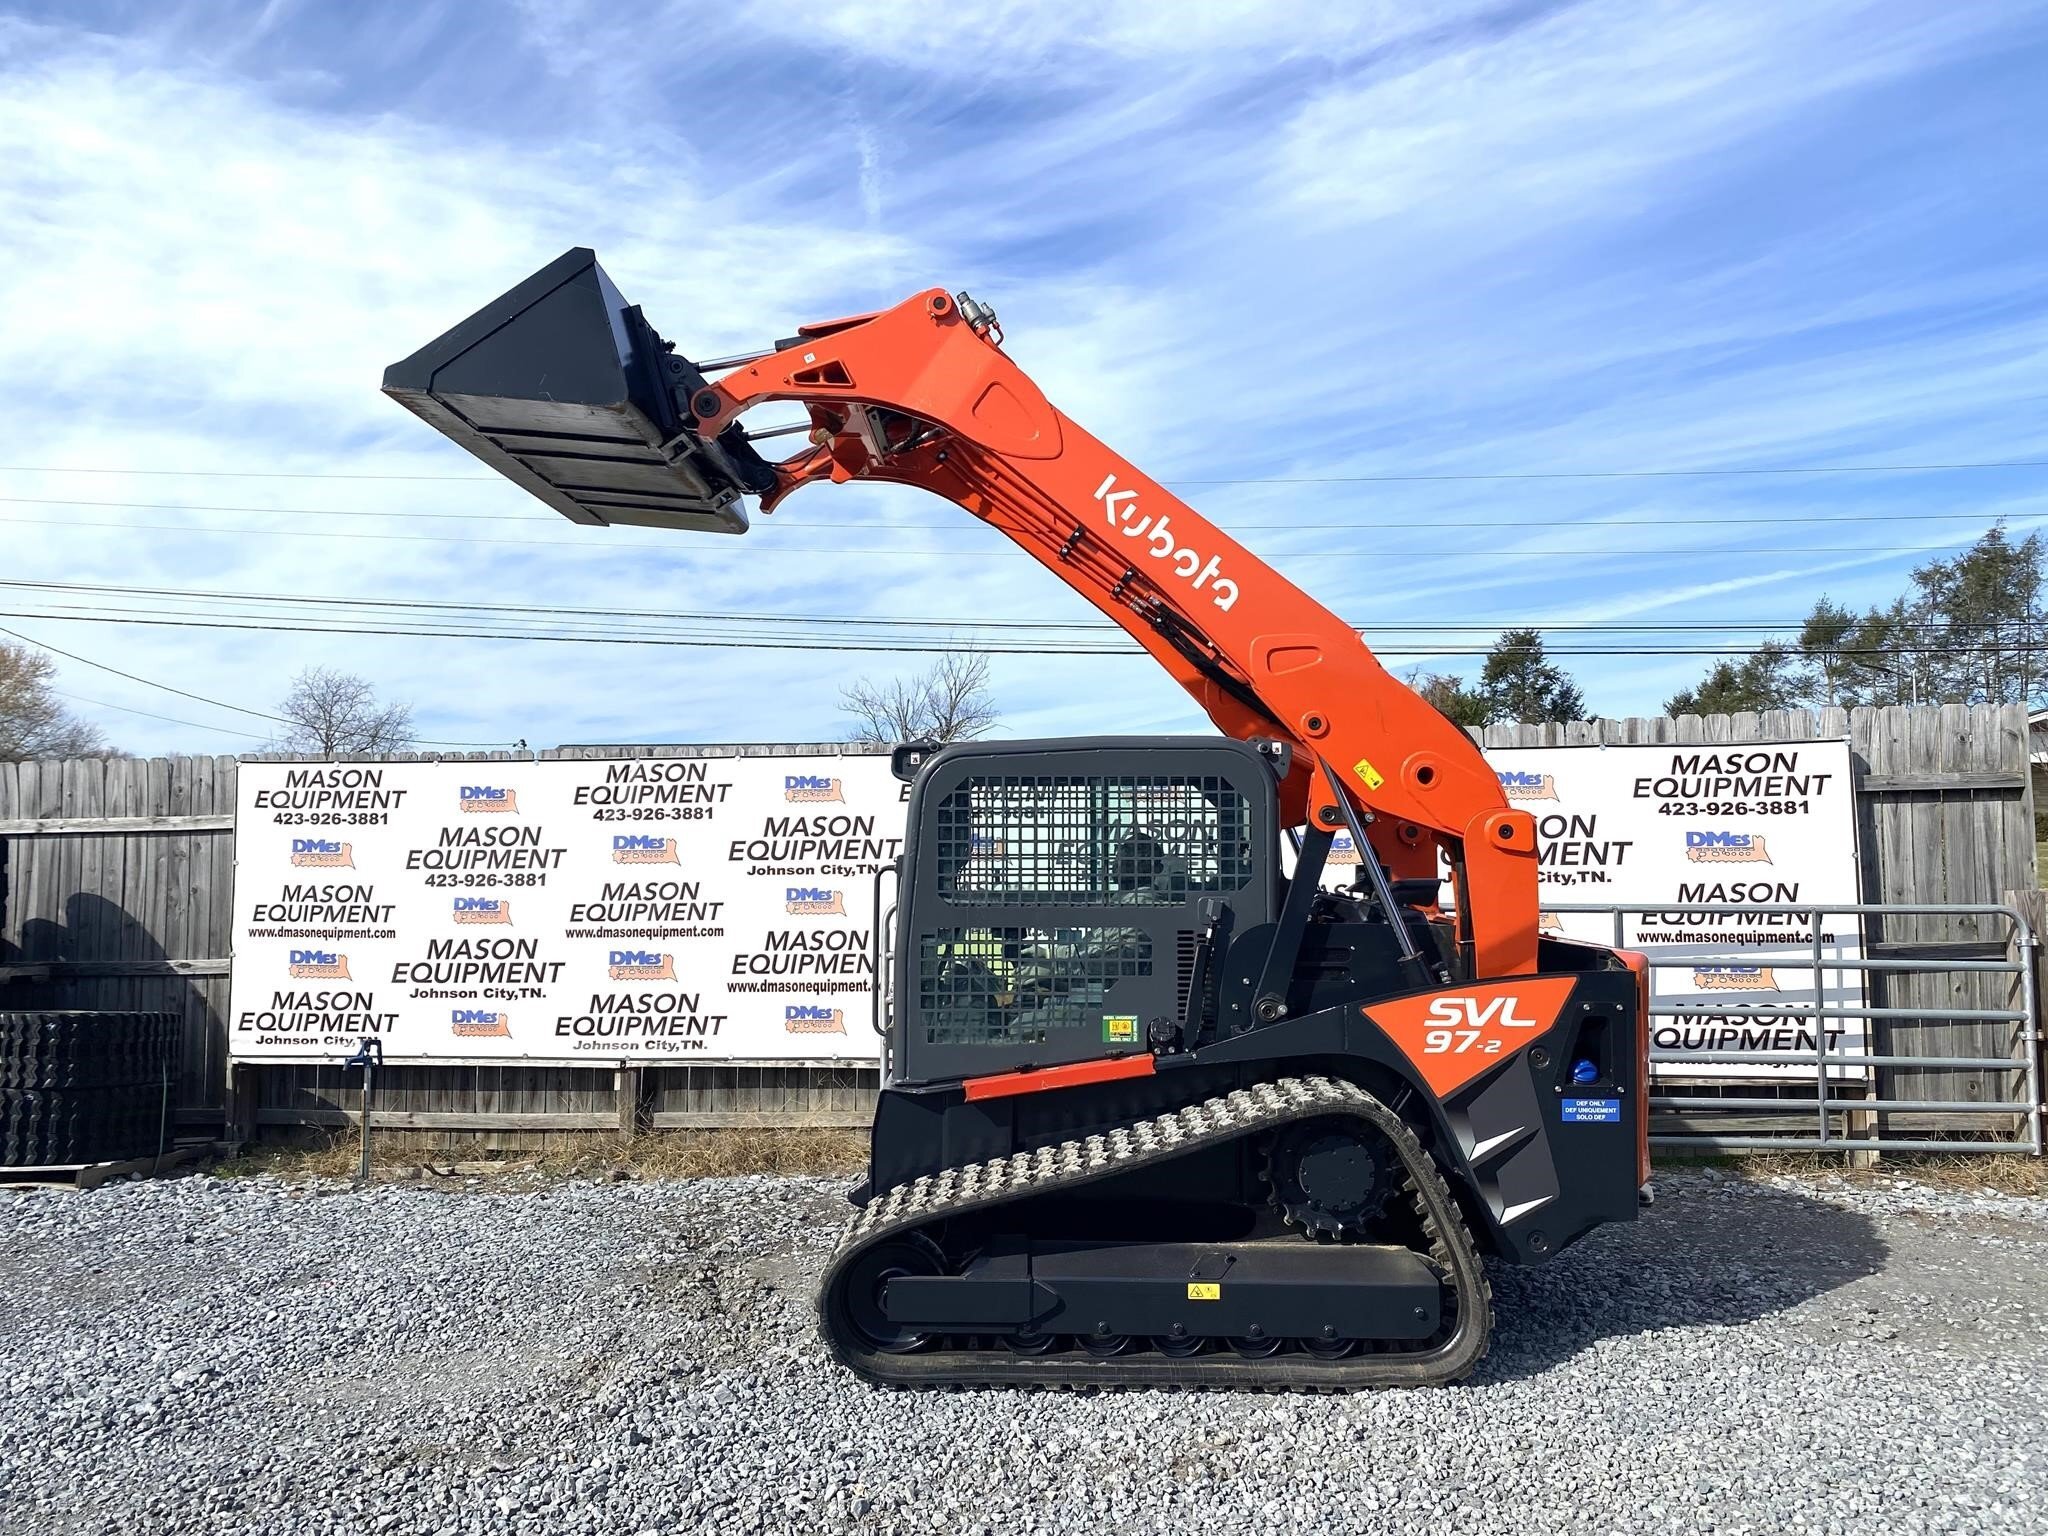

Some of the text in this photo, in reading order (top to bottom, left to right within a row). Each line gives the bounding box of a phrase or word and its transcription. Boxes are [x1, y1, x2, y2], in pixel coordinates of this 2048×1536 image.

[1093, 473, 1239, 612] Kubota
[606, 763, 707, 783] MASON
[1672, 752, 1798, 775] MASON
[286, 770, 382, 788] MASON
[1633, 775, 1832, 798] EQUIPMENT
[255, 791, 407, 809] EQUIPMENT
[574, 784, 732, 805] EQUIPMENT
[593, 807, 712, 821] 423-926-3881
[1659, 801, 1808, 815] 423-926-3881
[274, 813, 387, 825] 423-926-3881
[764, 816, 874, 837] MASON
[439, 827, 541, 847] MASON
[406, 849, 567, 869] EQUIPMENT
[728, 838, 902, 861] EQUIPMENT
[425, 873, 545, 887] 423-926-3881
[747, 866, 814, 875] Johnson
[282, 885, 373, 903] MASON
[601, 882, 699, 901] MASON
[1677, 883, 1799, 904] MASON
[253, 905, 395, 922] EQUIPMENT
[570, 903, 724, 922] EQUIPMENT
[249, 926, 395, 941] www.dmasonequipment.com
[566, 926, 723, 940] www.dmasonequipment.com
[765, 930, 869, 951] MASON
[1637, 930, 1835, 946] www.dmasonequipment.cm
[427, 939, 538, 959] MASON
[392, 963, 565, 983] EQUIPMENT
[731, 954, 874, 975] EQUIPMEN
[272, 992, 373, 1010] MASON
[410, 987, 547, 1001] Johnson City,TN.
[590, 994, 699, 1013] MASON
[1424, 997, 1537, 1027] SVL
[238, 1012, 399, 1032] EQUIPMENT
[555, 1016, 727, 1036] EQUIPMENT
[256, 1036, 318, 1046] Johnson
[572, 1040, 708, 1052] Johnson City,TN.
[1424, 1030, 1502, 1053] 97-2
[1650, 1027, 1845, 1051] QUIPMENT
